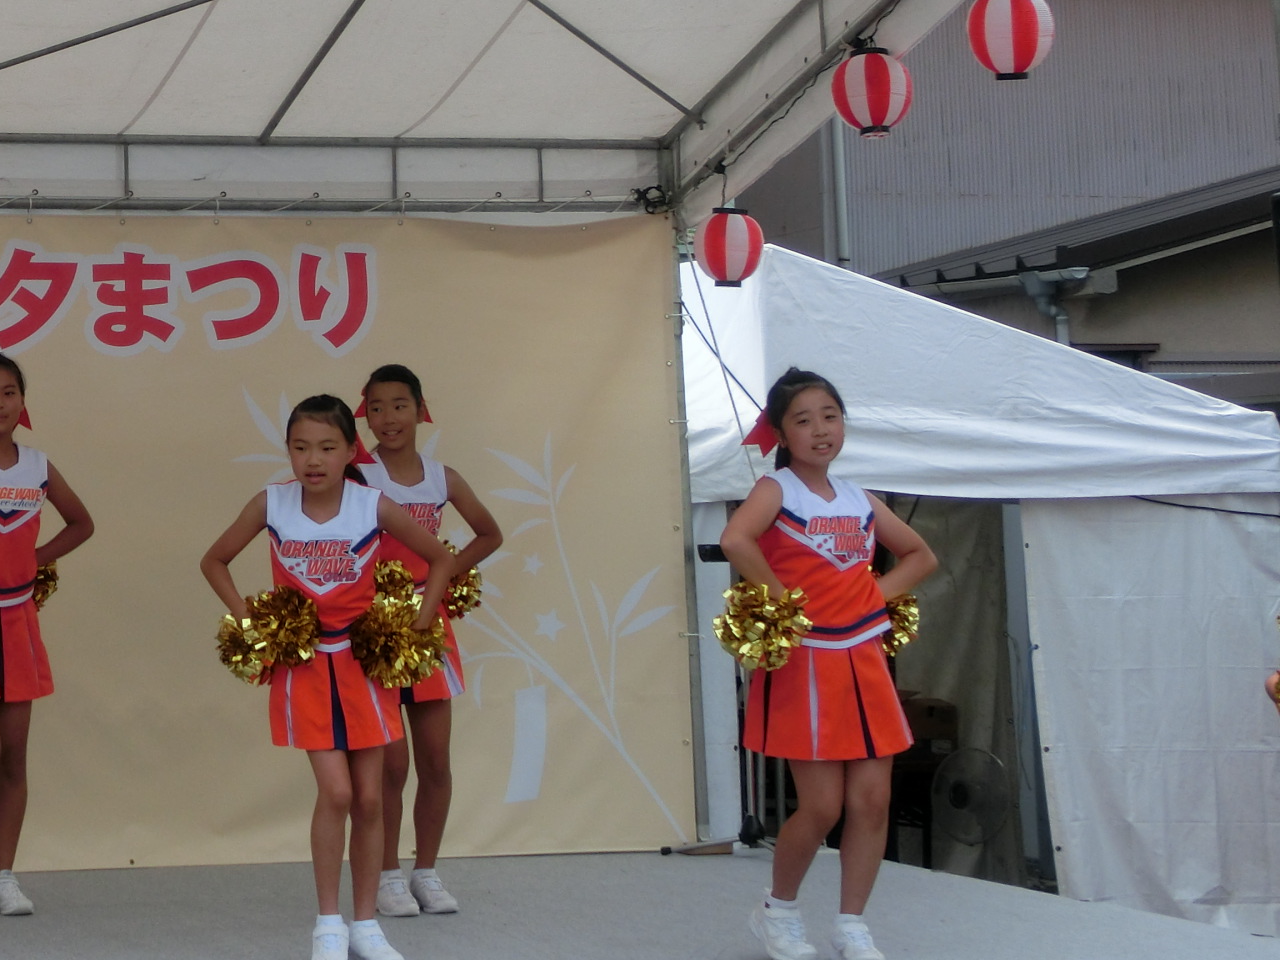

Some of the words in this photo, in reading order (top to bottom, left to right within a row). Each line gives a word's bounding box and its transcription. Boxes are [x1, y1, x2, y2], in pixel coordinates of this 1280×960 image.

[14, 488, 42, 502] WAVE
[807, 515, 862, 535] ORANGE
[280, 539, 352, 558] ORANGE
[833, 533, 867, 553] WAVE
[306, 556, 356, 576] WAVE
